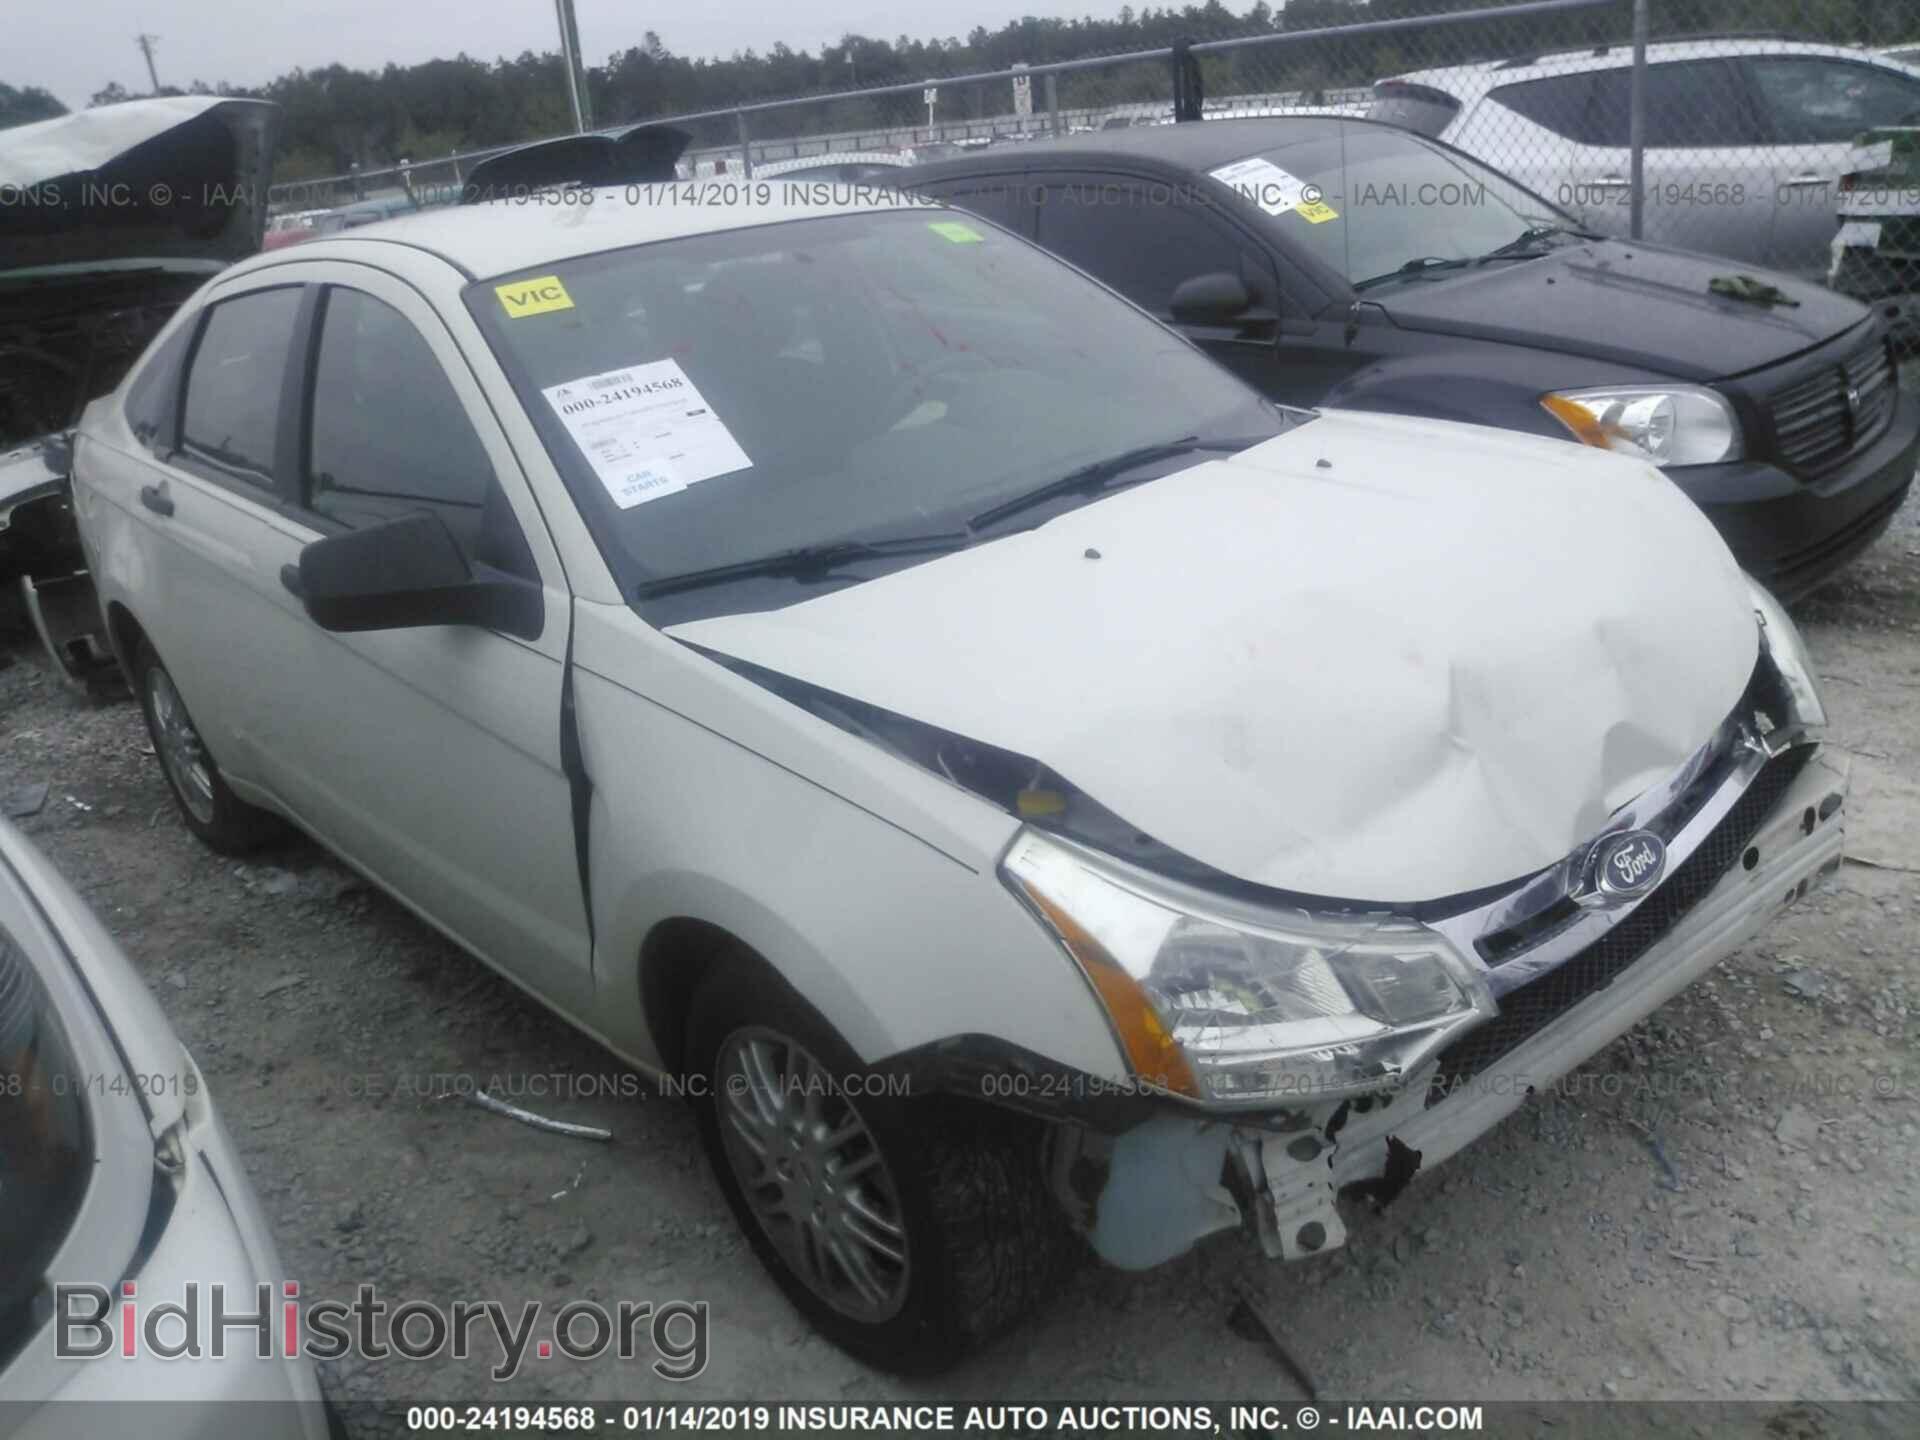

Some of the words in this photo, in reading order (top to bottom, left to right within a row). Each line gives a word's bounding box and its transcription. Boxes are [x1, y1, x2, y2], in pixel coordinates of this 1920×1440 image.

[505, 286, 561, 306] VIC
[562, 376, 684, 416] 000-24194568
[1613, 841, 1656, 884] Ford
